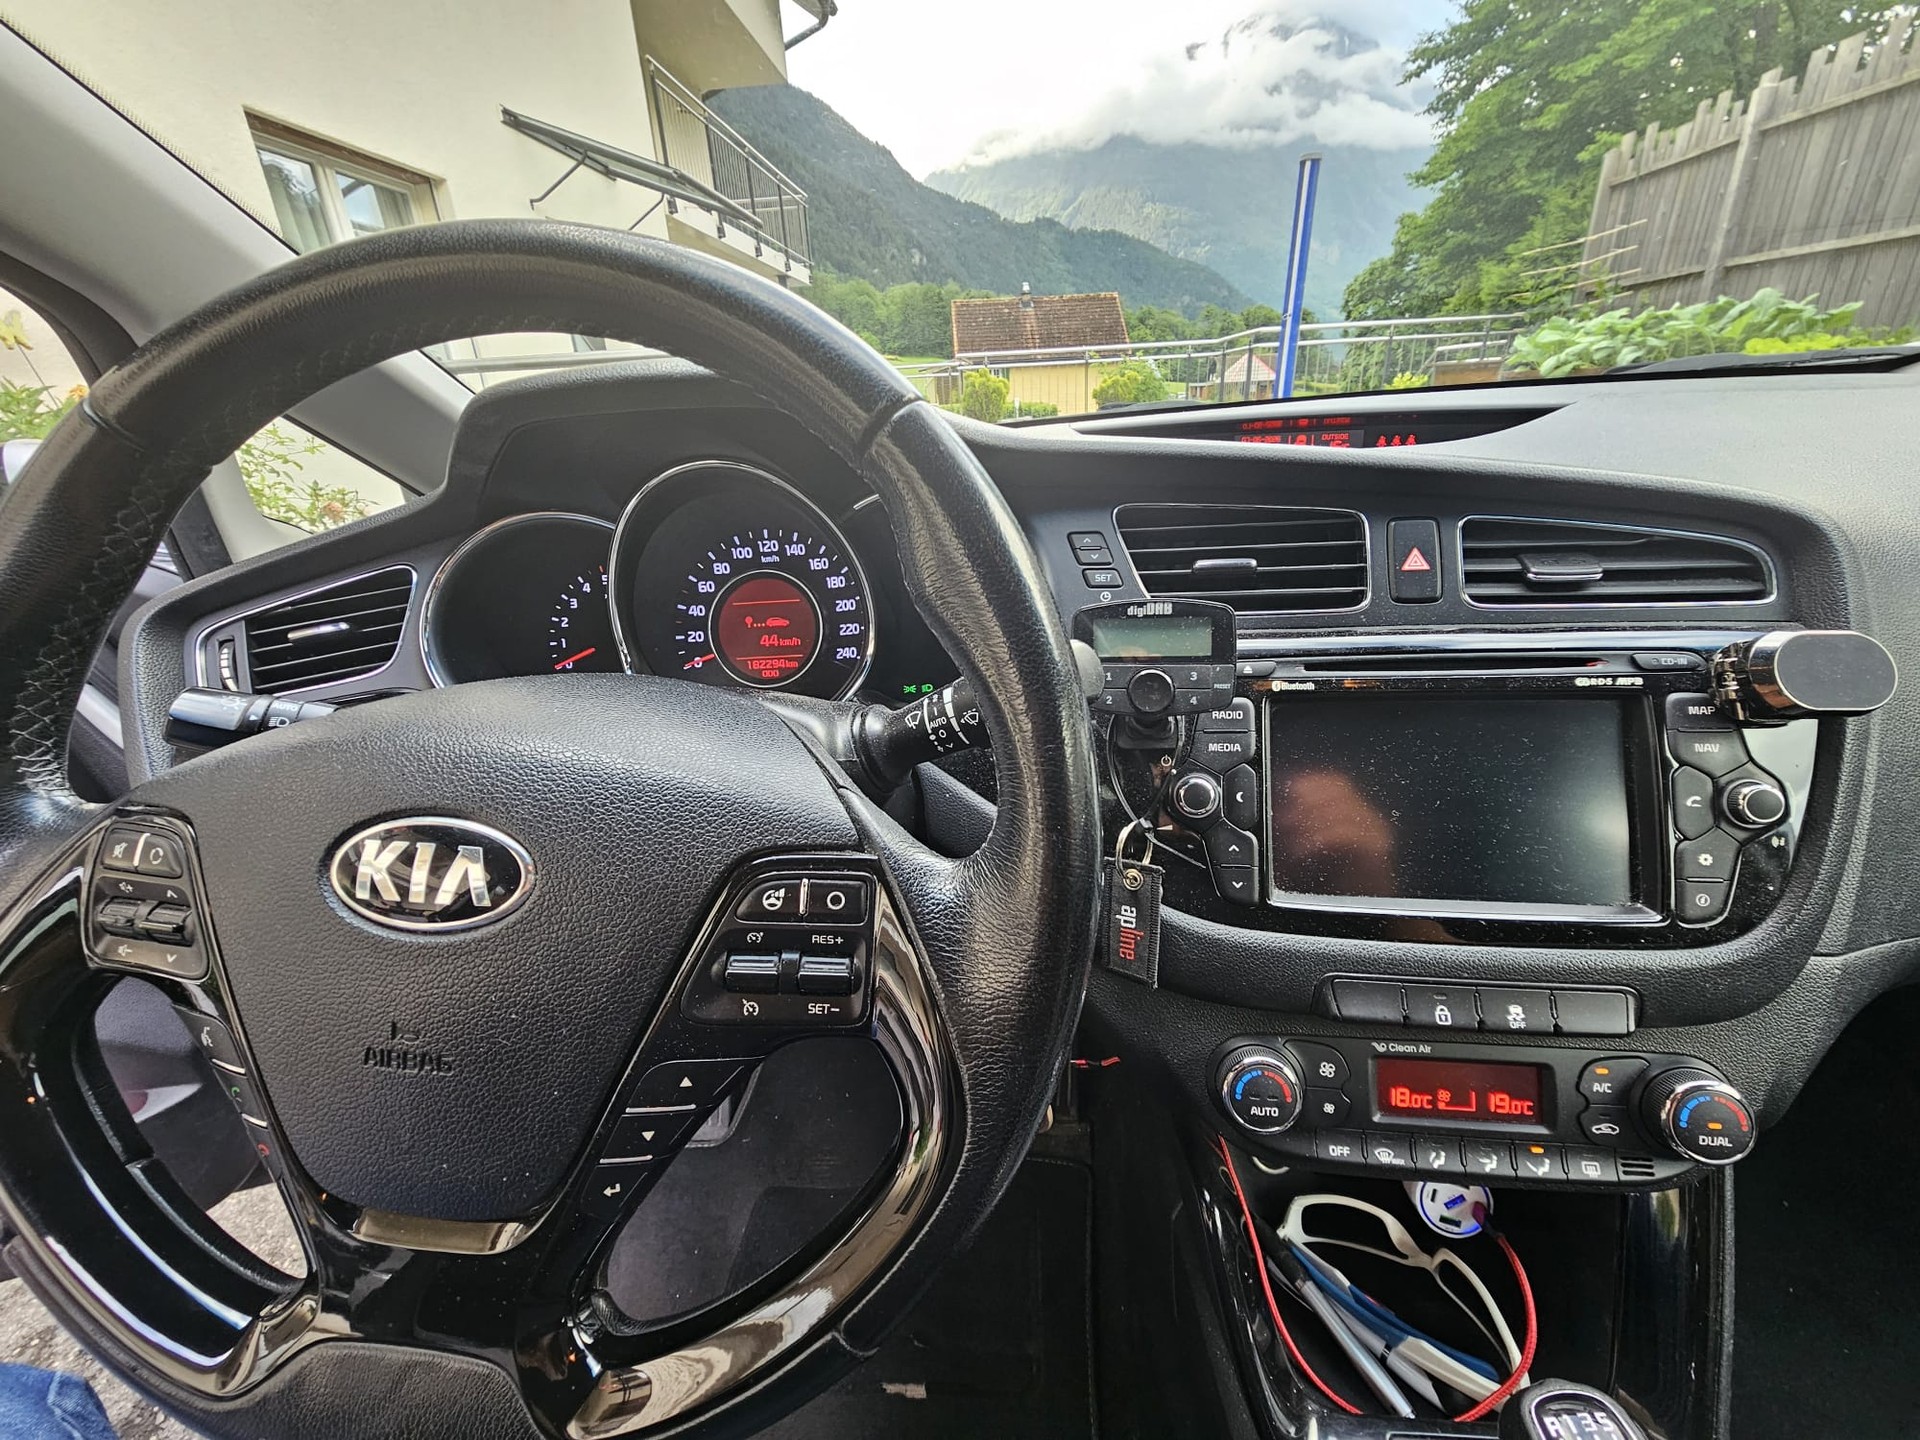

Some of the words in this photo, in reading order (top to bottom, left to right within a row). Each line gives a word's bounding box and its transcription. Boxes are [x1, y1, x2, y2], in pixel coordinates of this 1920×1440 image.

[1321, 433, 1349, 441] OUTSIDE
[757, 540, 779, 553] 120
[784, 544, 806, 556] 140
[731, 547, 753, 559] 100
[760, 555, 780, 563] km/h
[808, 558, 829, 571] 160
[712, 562, 731, 575] 80
[825, 576, 846, 589] 180
[1094, 574, 1112, 582] SET
[582, 582, 591, 593] 4
[697, 581, 715, 593] 60
[569, 598, 578, 609] 3
[835, 599, 857, 612] 200
[688, 604, 706, 617] 40
[1127, 602, 1173, 617] digiDAB
[560, 617, 569, 628] 2
[839, 623, 860, 636] 220
[687, 631, 705, 642] 20
[560, 638, 566, 649] 1
[836, 647, 857, 660] 240
[1105, 672, 1113, 680] 1
[1190, 672, 1198, 680] 3
[1281, 682, 1315, 691] Bluetooth
[1106, 696, 1113, 704] 2
[1189, 696, 1198, 705] 4
[1212, 710, 1243, 720] RADIO
[1688, 706, 1716, 715] MAP
[929, 716, 947, 729] AUTO
[1208, 743, 1242, 752] MEDIA
[1694, 743, 1720, 753] NAV
[355, 839, 492, 907] KIA
[811, 934, 844, 945] RES+
[807, 1003, 841, 1015] SET-
[1509, 1021, 1526, 1029] OFF
[1389, 1043, 1417, 1053] Clean
[1418, 1044, 1432, 1053] Air
[363, 1047, 453, 1075] AIRBAG
[1592, 1083, 1612, 1093] A/C
[1250, 1106, 1279, 1117] AUTO
[1698, 1135, 1733, 1147] DUAL
[1328, 1145, 1351, 1157] OFF
